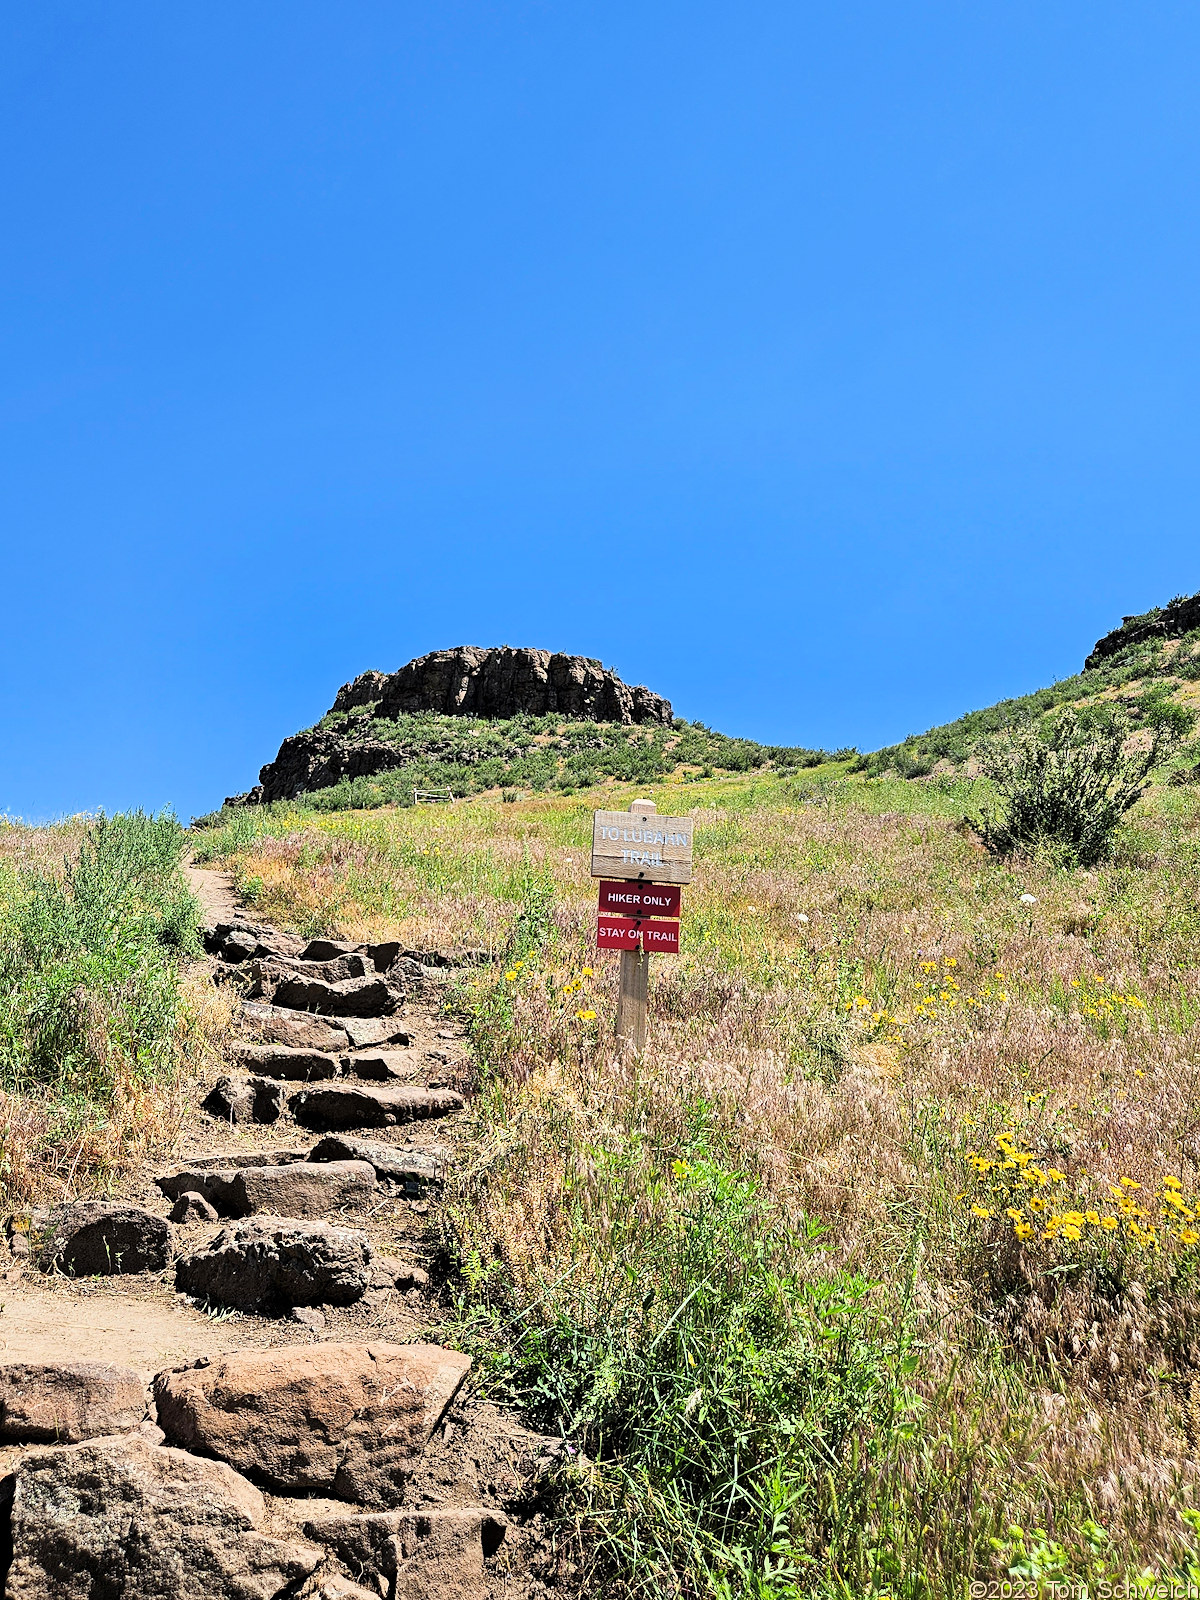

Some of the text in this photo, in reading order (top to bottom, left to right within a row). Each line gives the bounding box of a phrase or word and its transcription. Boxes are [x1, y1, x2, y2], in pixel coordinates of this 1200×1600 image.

[600, 825, 688, 847] TO LUBAHN
[621, 849, 665, 867] TRAIL
[608, 892, 672, 907] HIKER ONLY
[599, 927, 626, 938] STAY
[647, 931, 678, 943] TRAIL
